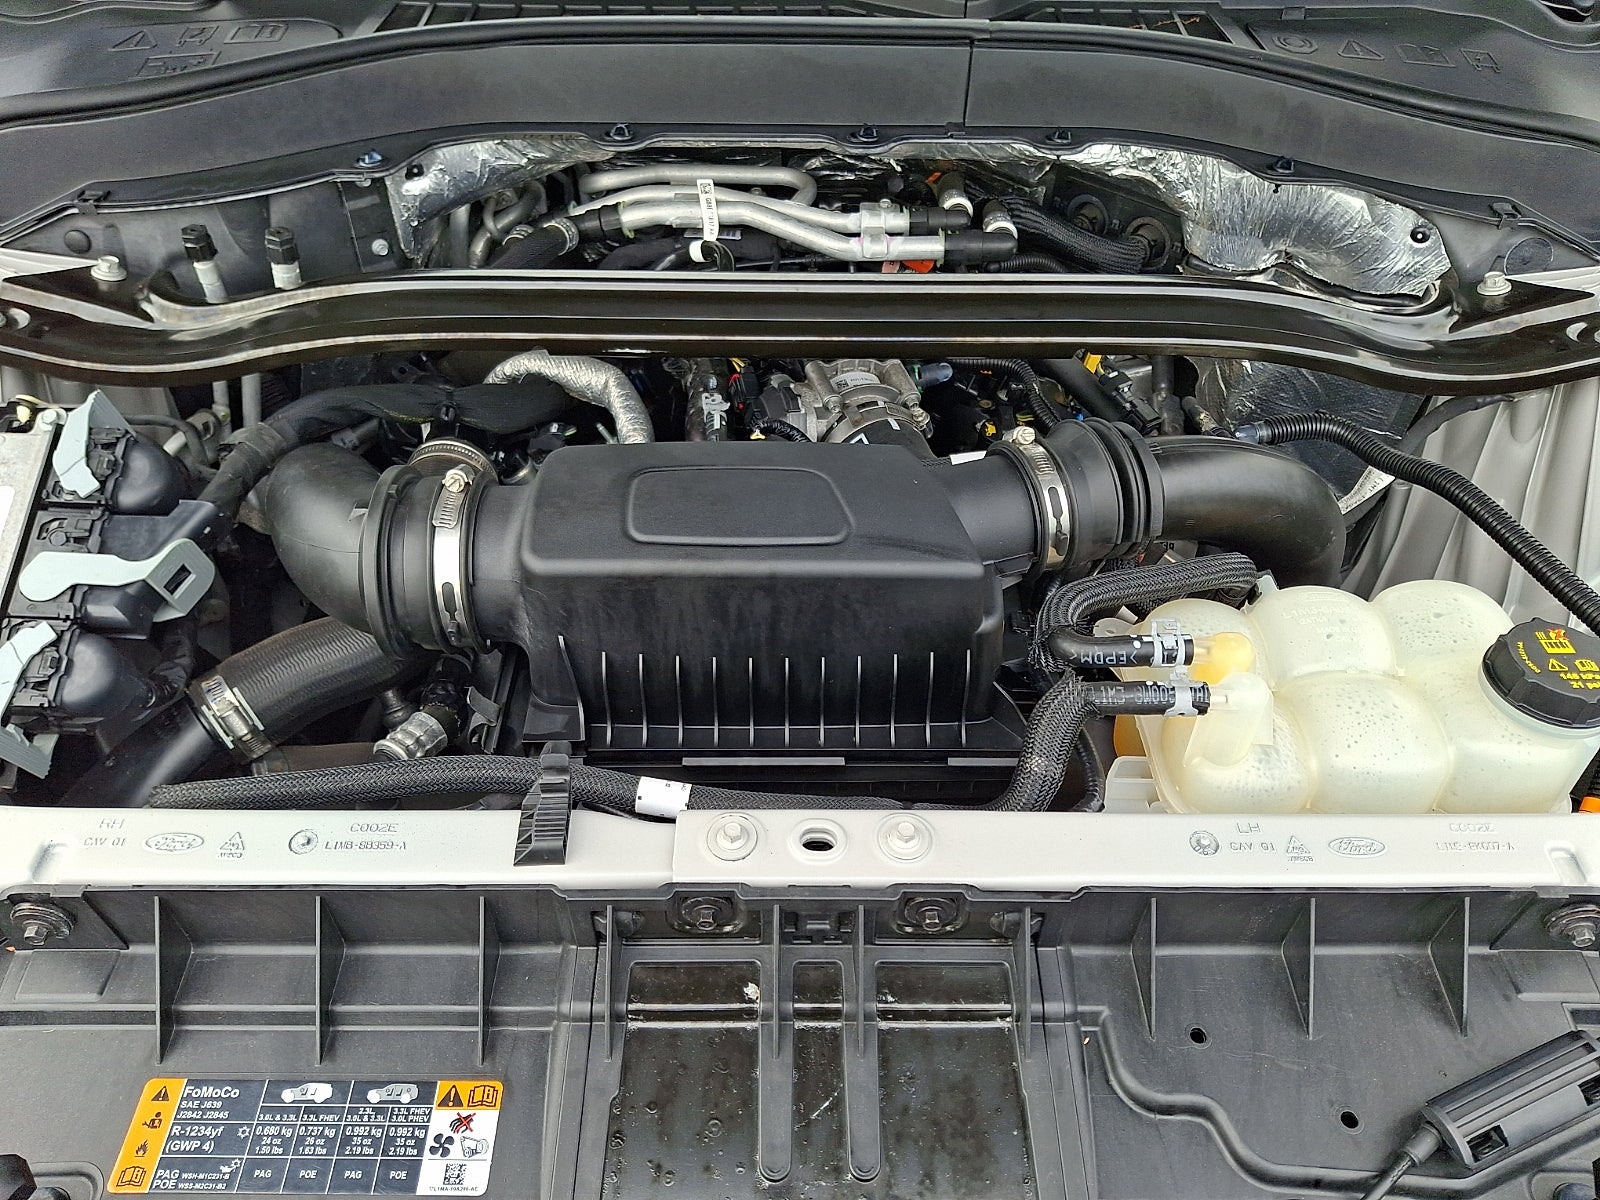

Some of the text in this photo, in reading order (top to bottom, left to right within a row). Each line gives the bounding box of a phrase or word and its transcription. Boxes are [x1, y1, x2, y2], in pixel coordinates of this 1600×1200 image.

[99, 818, 125, 829] RH
[1237, 822, 1261, 833] LH
[83, 837, 106, 847] CAV
[1230, 842, 1253, 851] CAV
[183, 1086, 240, 1099] FoMoCo
[180, 1101, 222, 1109] SAE J639
[176, 1111, 229, 1119] J2842 J2845
[170, 1126, 225, 1139] R-1234yf
[256, 1126, 293, 1137] 0.680 kg
[300, 1127, 336, 1138] 0.737 kg
[346, 1127, 382, 1138] 0.992 kg
[389, 1127, 426, 1138] 0.992 kg
[261, 1137, 271, 1145] 24
[305, 1137, 315, 1145] 26
[395, 1138, 405, 1146] 35
[165, 1141, 214, 1153] (GWP 4)
[255, 1146, 284, 1154] 1.50 lbs
[299, 1147, 327, 1155] 1.63 lbs
[345, 1147, 374, 1155] 2.19 lbs
[388, 1147, 418, 1156] 2.19 lbs
[156, 1170, 180, 1179] PAG
[253, 1170, 272, 1178] PAG
[299, 1170, 318, 1179] POE
[343, 1171, 363, 1179] PAG
[389, 1171, 408, 1180] POE
[152, 1180, 177, 1189] POE
